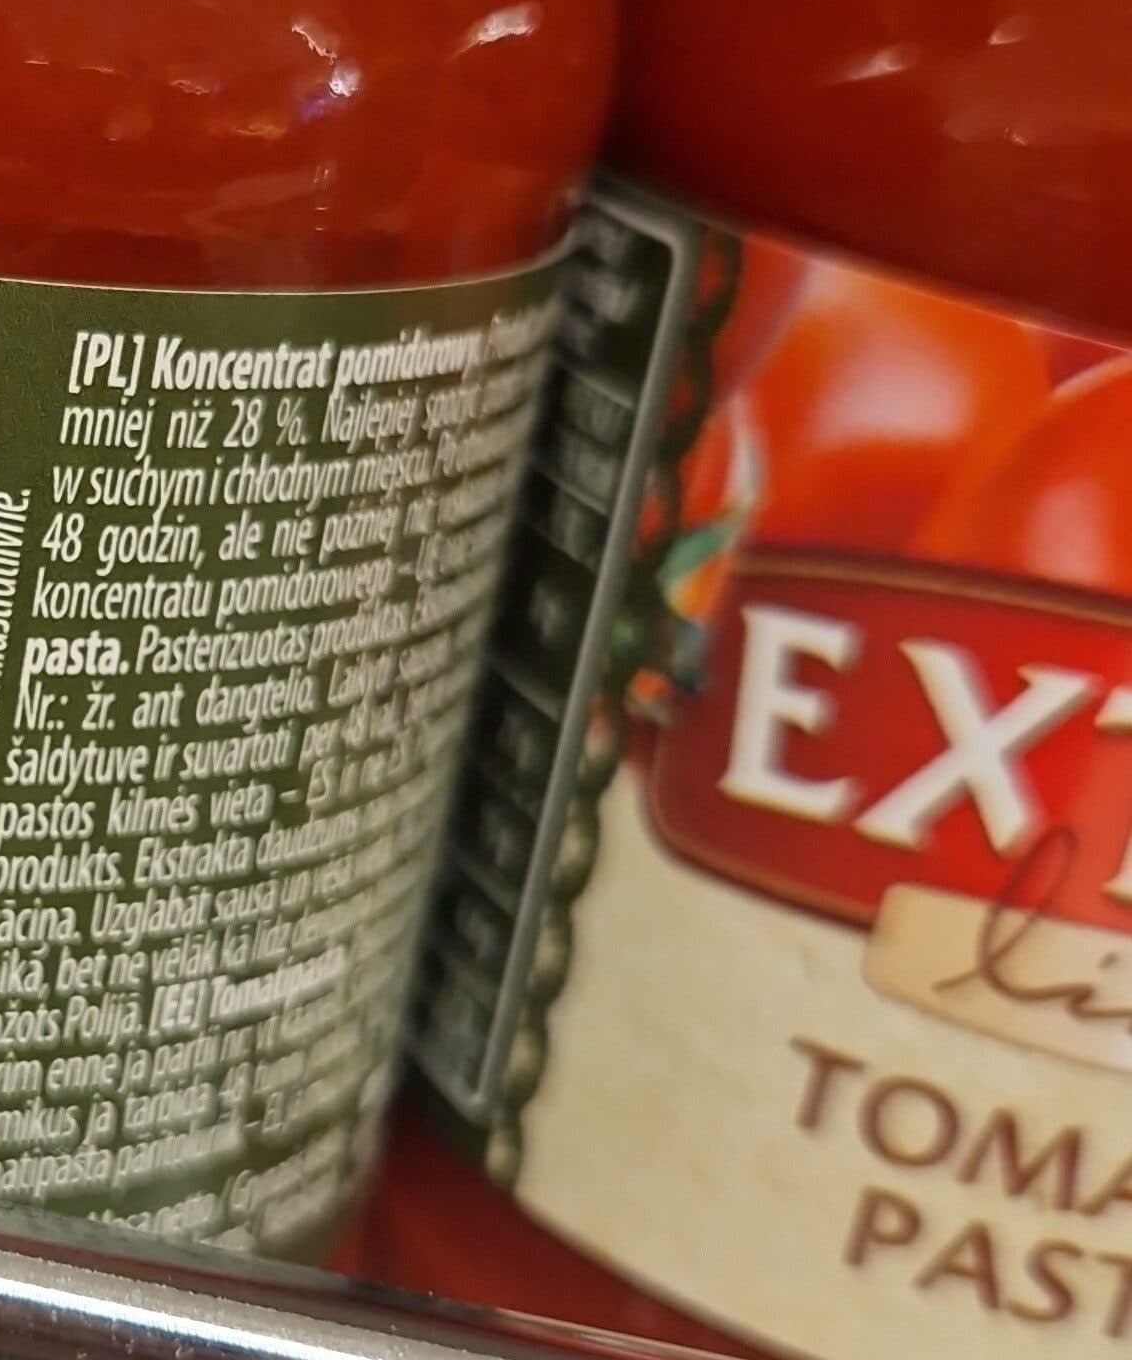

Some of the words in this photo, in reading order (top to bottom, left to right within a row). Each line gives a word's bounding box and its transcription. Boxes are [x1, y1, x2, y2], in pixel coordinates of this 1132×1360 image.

[68, 331, 146, 397] [PL]
[150, 336, 333, 391] Koncentrat
[59, 396, 156, 462] mniej
[166, 397, 215, 449] niż
[222, 396, 264, 448] 28
[276, 396, 308, 447] %.
[320, 386, 421, 455] Najlepiej
[52, 465, 85, 505] w
[85, 454, 207, 522] suchym
[208, 455, 224, 506] i
[222, 449, 352, 514] chłodnym
[42, 512, 85, 563] 48
[97, 513, 207, 577] godzin,
[218, 508, 263, 561] ale
[270, 506, 315, 558] nie
[31, 565, 213, 620] koncentratu
[214, 555, 396, 630] pomidorowego
[19, 628, 130, 690] pasta.
[134, 618, 310, 676] Pasterizuotas
[13, 680, 69, 731] Nr.:
[81, 680, 116, 731] žr.
[132, 682, 183, 729] ant
[3, 733, 149, 802] šaldytuve
[153, 733, 180, 782] ir
[179, 717, 295, 780] suvartoti
[106, 784, 201, 838] kilmės
[209, 776, 275, 829] vieta
[132, 826, 256, 888] Ekstrakta
[90, 883, 213, 953] Uzglabāt
[55, 943, 108, 998] bet
[109, 950, 149, 992] ne
[46, 1052, 118, 1100] enne
